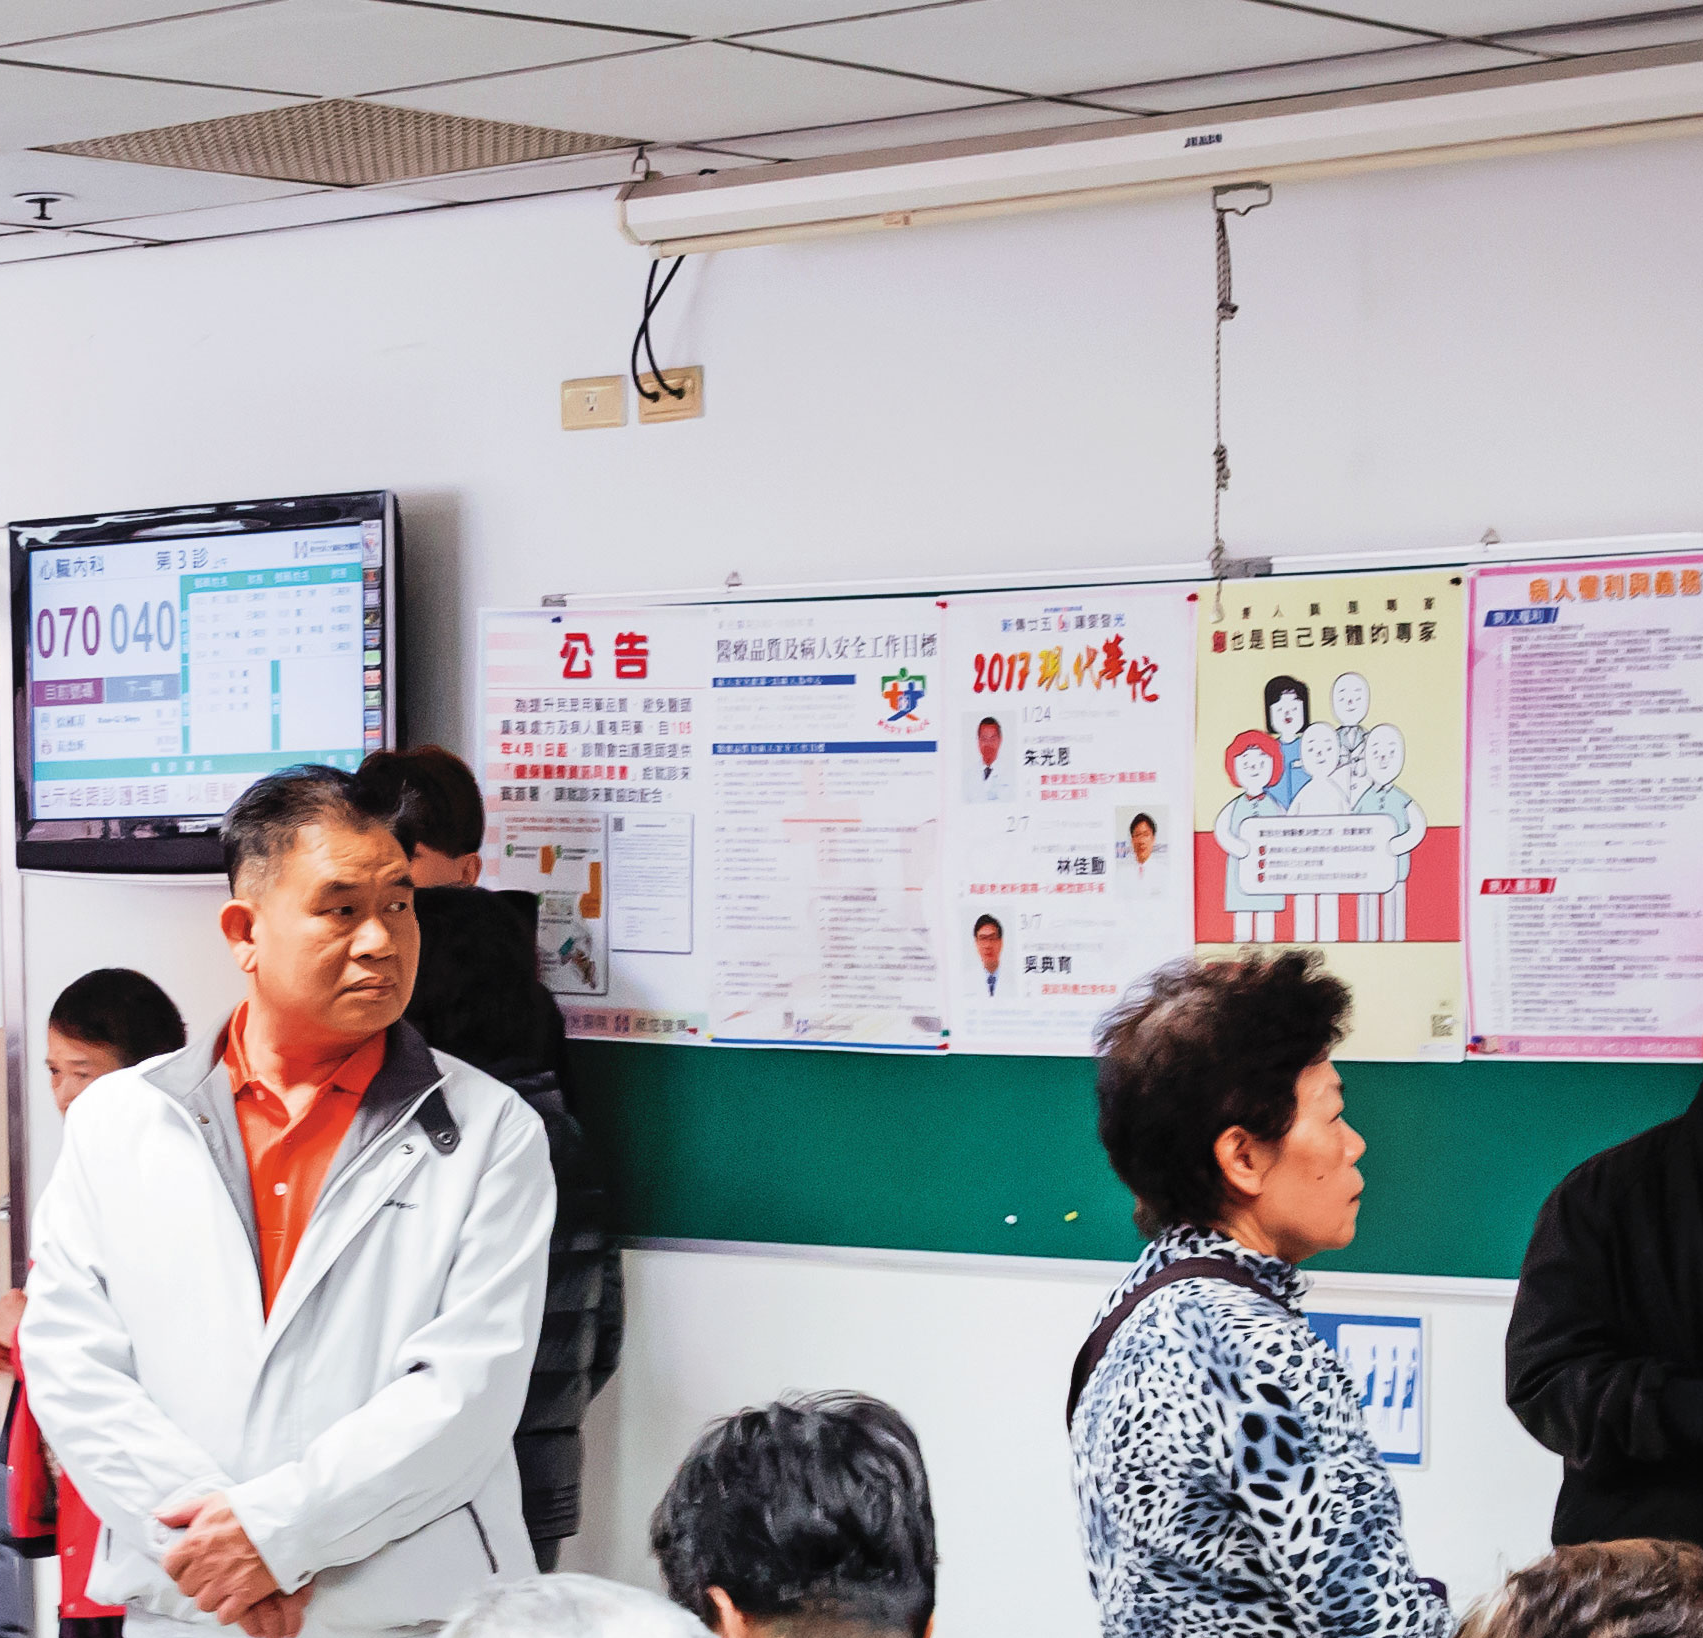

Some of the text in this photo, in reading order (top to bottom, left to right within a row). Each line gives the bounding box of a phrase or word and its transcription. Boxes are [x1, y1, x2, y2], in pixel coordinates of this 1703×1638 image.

[155, 547, 209, 571] 第3診
[36, 604, 101, 659] 070
[110, 600, 176, 655] 040
[560, 632, 650, 680] 公告
